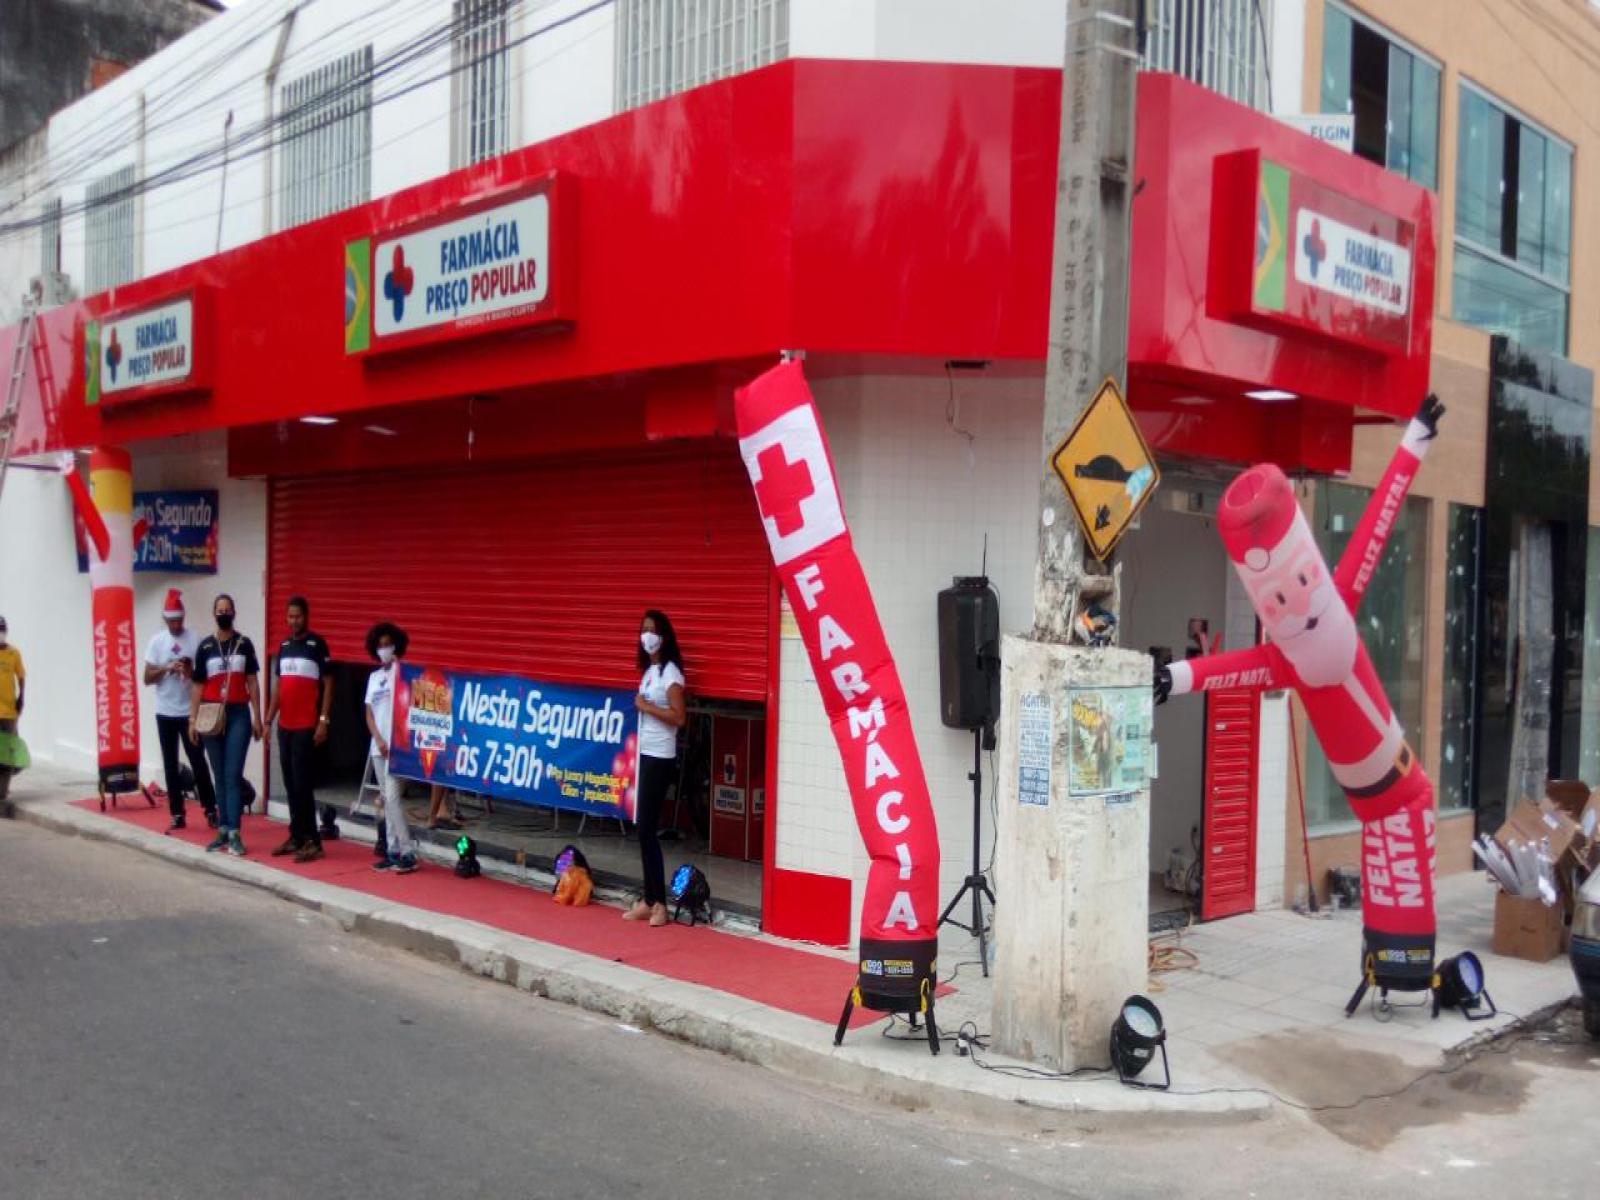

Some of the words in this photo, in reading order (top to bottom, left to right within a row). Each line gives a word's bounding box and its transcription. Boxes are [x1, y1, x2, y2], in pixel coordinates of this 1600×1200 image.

[440, 216, 520, 276] FARMÁCIA
[1344, 238, 1394, 279] FARMÁCIA
[426, 277, 469, 316] PREÇO
[471, 257, 536, 304] POPULAR
[1333, 265, 1363, 297] PREÇO
[1364, 273, 1403, 306] POPULAR
[152, 344, 186, 374] POPULAR
[1352, 537, 1384, 592] FELIZ
[1374, 473, 1411, 538] NATAL
[1202, 671, 1240, 691] FELIZ
[458, 681, 521, 730] Nesta
[523, 689, 625, 749] Segunda
[454, 734, 480, 778] às
[482, 739, 543, 790] 7:30h
[794, 562, 918, 931] FARMÁCIA
